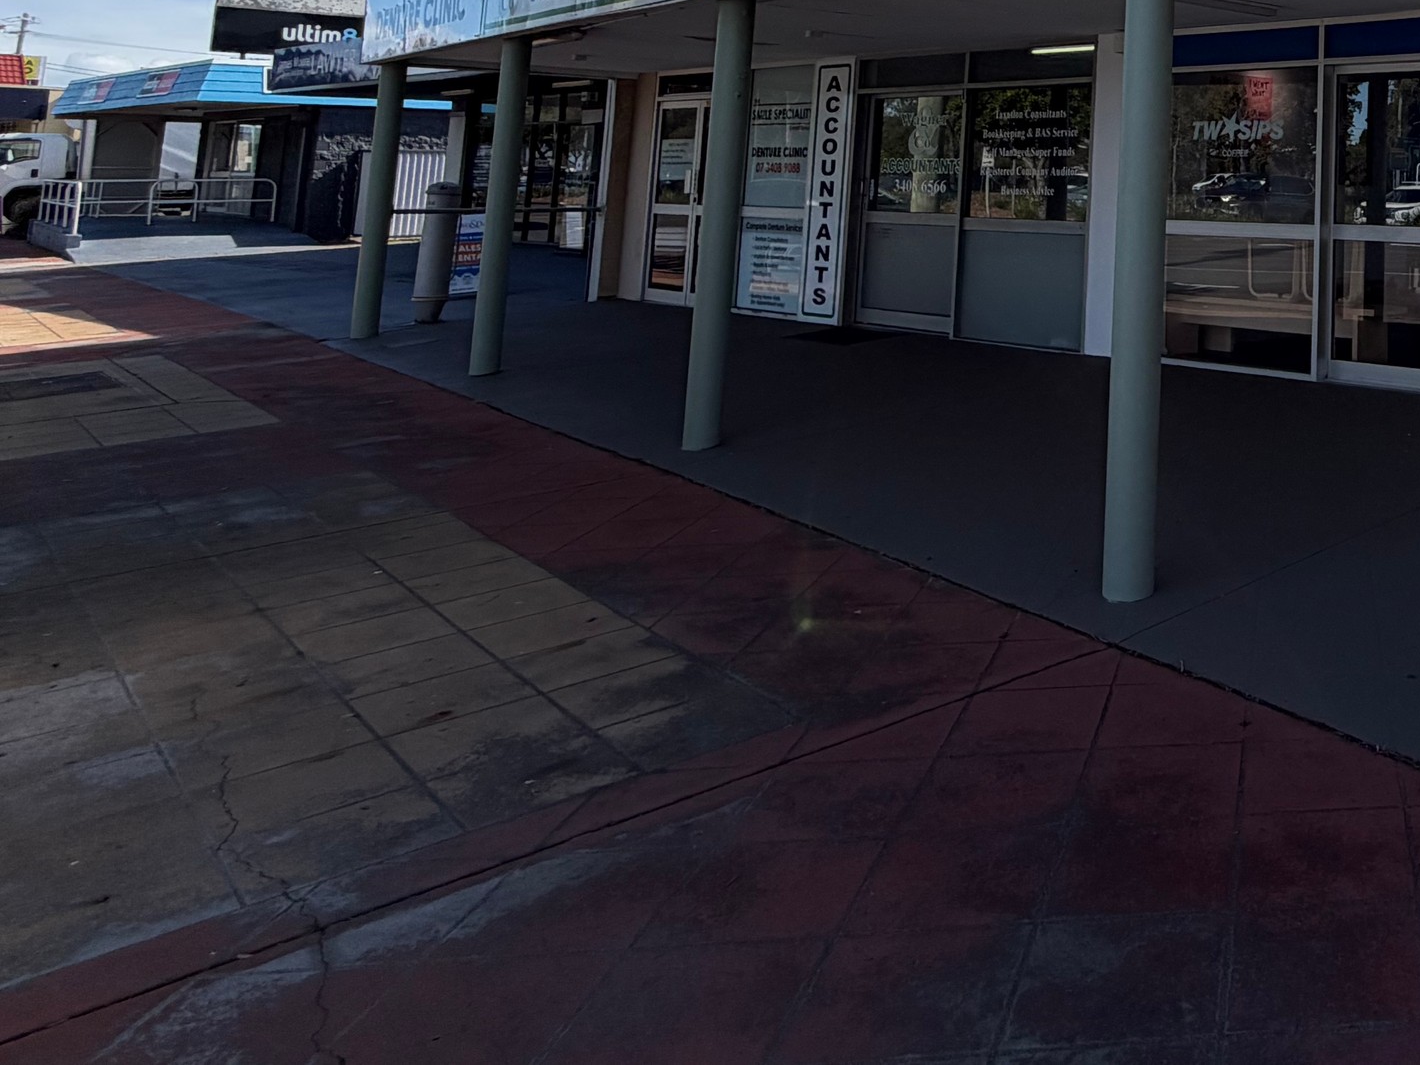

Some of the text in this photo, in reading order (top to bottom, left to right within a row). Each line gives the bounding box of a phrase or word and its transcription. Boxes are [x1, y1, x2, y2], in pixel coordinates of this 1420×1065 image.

[282, 23, 358, 44] ultim8
[1024, 107, 1067, 119] Consultants
[982, 128, 1026, 141] Bookkeeping
[1026, 127, 1033, 138] &
[1034, 127, 1051, 138] BAS
[782, 146, 808, 158] CLINIC
[1030, 146, 1051, 158] Super
[1053, 146, 1075, 157] Funds
[1221, 148, 1249, 157] COFFEE
[880, 157, 961, 174] ACCOUNTANTS
[812, 75, 842, 305] ACCOUNTANTS
[921, 179, 947, 194] 6566
[1000, 185, 1055, 196] Business Advice
